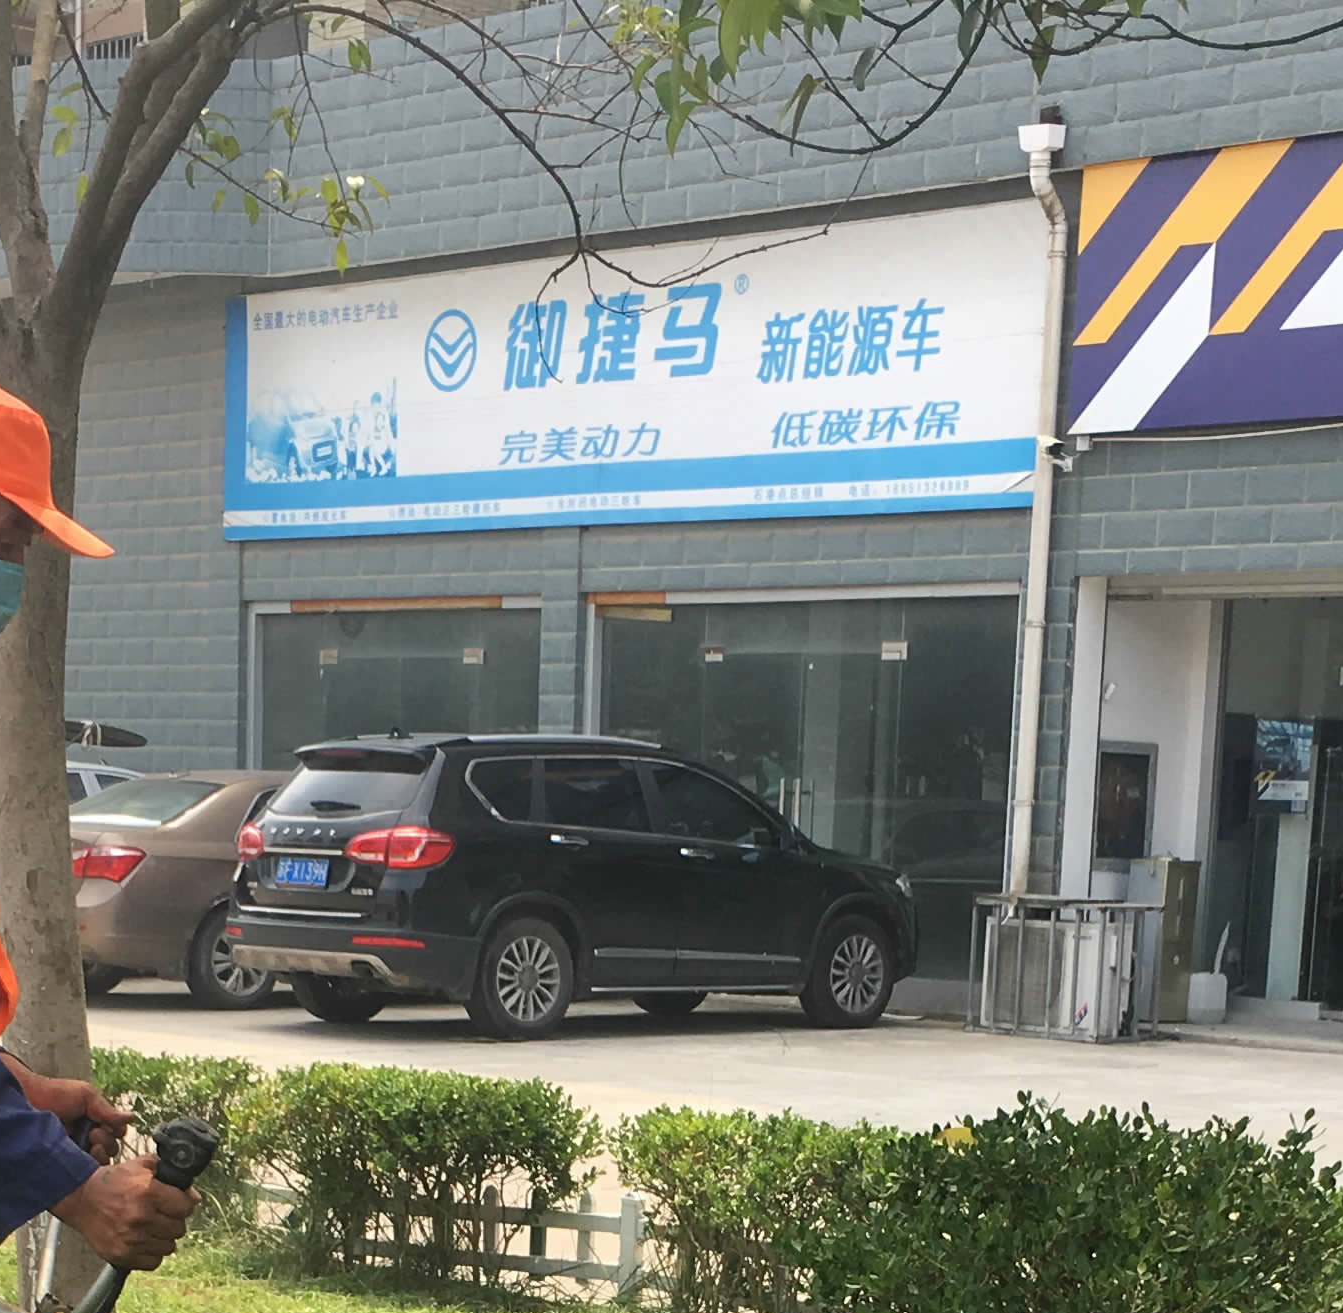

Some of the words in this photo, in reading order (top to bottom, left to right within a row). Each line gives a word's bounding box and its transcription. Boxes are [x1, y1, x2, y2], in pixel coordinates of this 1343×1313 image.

[252, 300, 399, 331] 全国最大的电动汽车生产企业
[502, 281, 723, 391] 御捷马
[756, 297, 946, 385] 新能源车
[497, 422, 662, 466] 完美动力
[770, 400, 962, 449] 低碳环保
